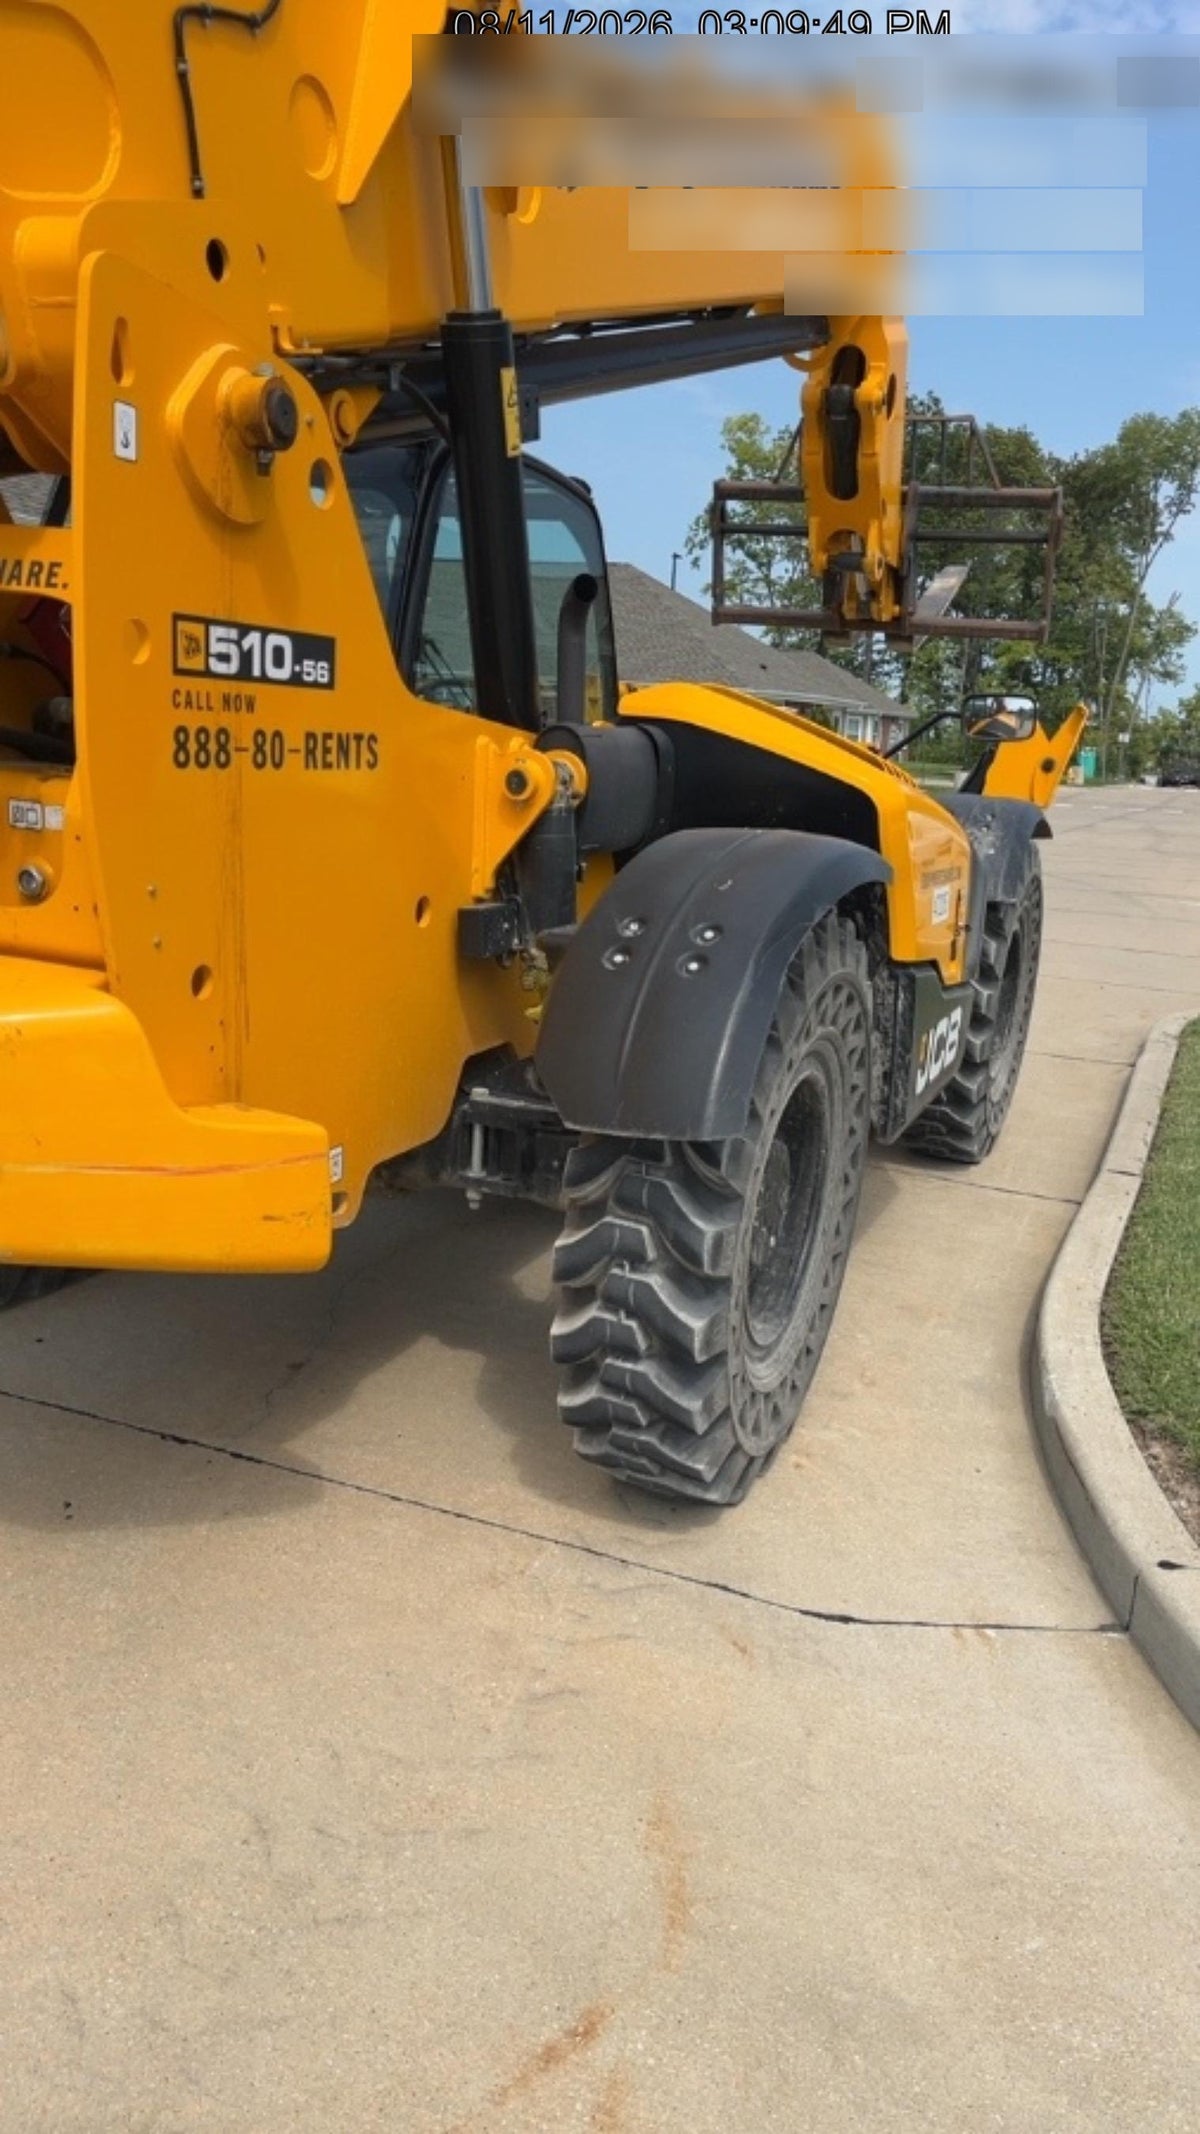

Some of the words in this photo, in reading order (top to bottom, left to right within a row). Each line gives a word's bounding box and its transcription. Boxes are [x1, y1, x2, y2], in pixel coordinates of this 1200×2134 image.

[172, 689, 214, 711] CALL
[222, 693, 256, 714] NOW
[173, 725, 379, 771] 888-80-RENTS
[914, 1005, 963, 1096] JCB
